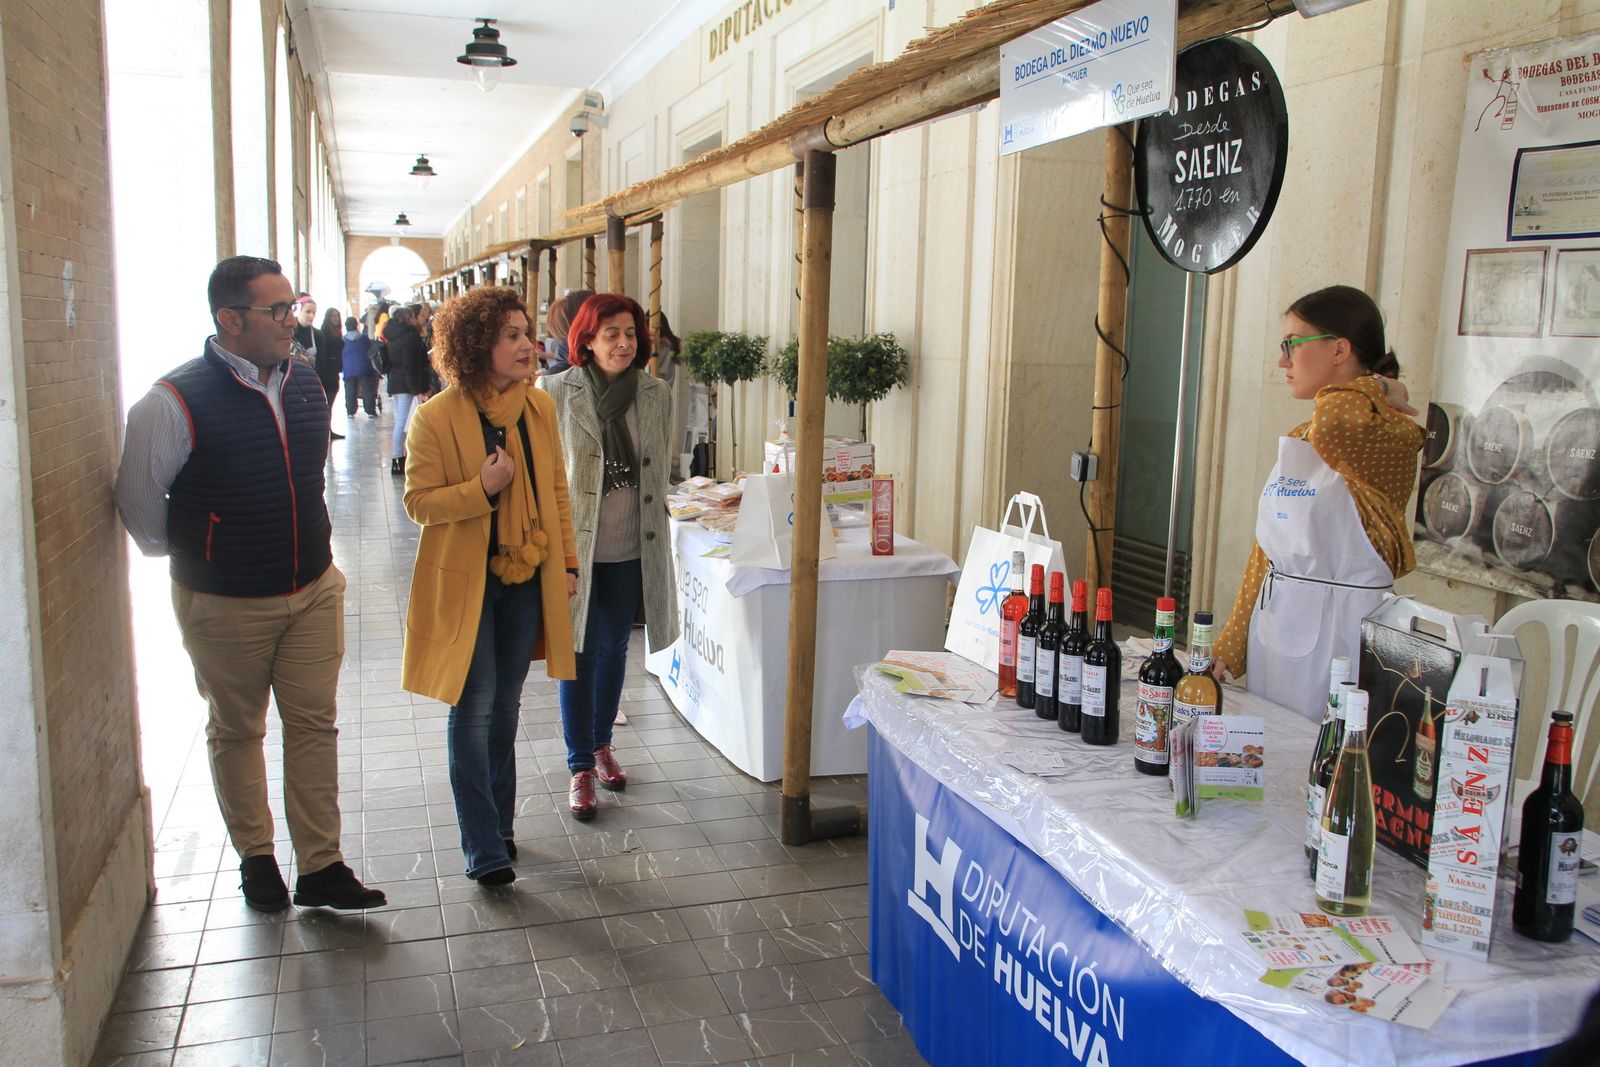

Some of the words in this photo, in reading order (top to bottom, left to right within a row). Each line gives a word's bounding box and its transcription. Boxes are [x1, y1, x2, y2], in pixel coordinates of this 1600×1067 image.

[1015, 55, 1048, 81] BODEGA
[1050, 49, 1068, 68] DEL
[1070, 31, 1107, 59] DIEZMO
[1110, 15, 1149, 45] NUEVO
[1565, 55, 1590, 71] DEL
[1061, 67, 1088, 85] MOGUER
[1127, 84, 1139, 96] Que
[1140, 81, 1153, 91] sea
[1154, 71, 1261, 117] ODEGAS
[1559, 87, 1577, 97] CASA
[1135, 90, 1161, 106] Huelva
[1175, 139, 1242, 184] SAENZ
[1219, 187, 1240, 202] en
[1483, 441, 1504, 453] SAENZ
[1569, 447, 1597, 460] SAENZ
[1286, 478, 1308, 487] sea
[1277, 487, 1316, 496] Huelva
[1441, 501, 1460, 513] SAENZ
[875, 481, 891, 553] OLIBEAS
[1510, 522, 1534, 538] SAENZ
[683, 607, 725, 675] Huelva
[1447, 874, 1487, 891] NARANJA
[961, 859, 1125, 1042] DIPUTACIÓN
[960, 908, 986, 968] DE
[994, 941, 1110, 1067] HUELVA
